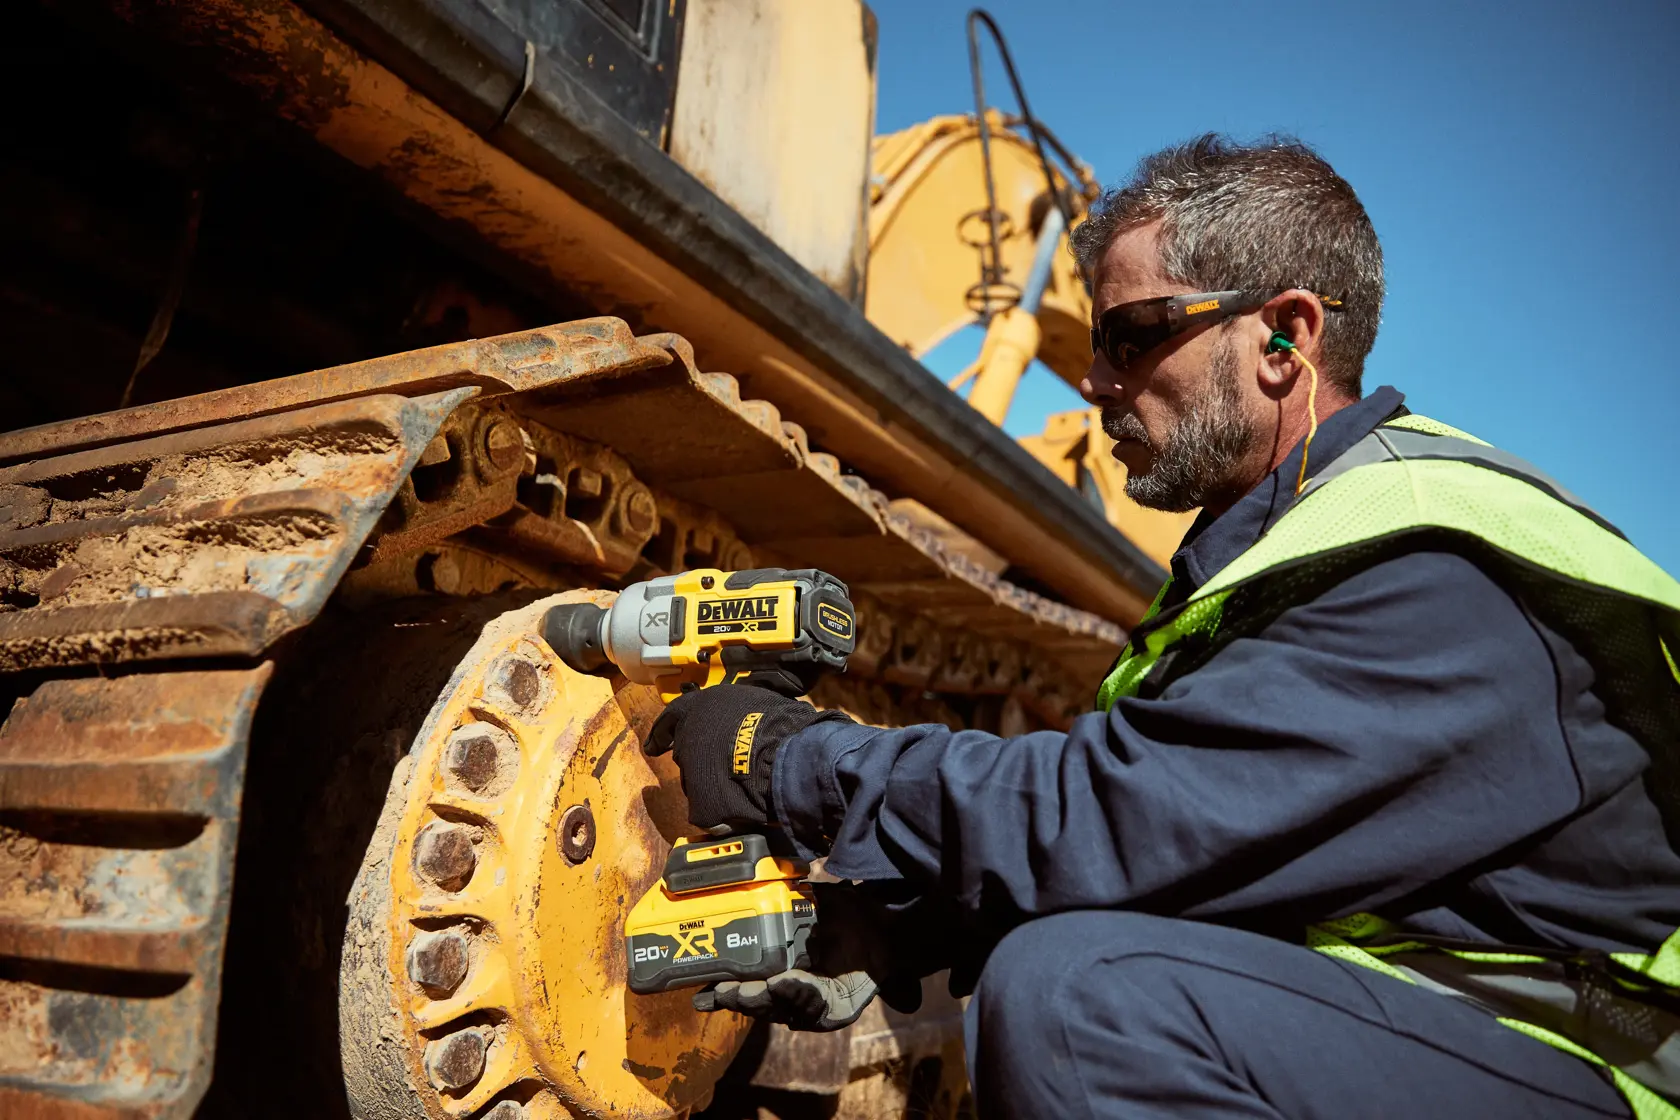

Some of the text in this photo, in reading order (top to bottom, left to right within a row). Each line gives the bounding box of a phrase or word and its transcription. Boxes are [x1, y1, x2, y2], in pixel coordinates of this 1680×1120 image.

[644, 611, 669, 628] XR
[741, 621, 759, 633] XR
[671, 927, 718, 959] XR
[672, 952, 714, 964] POWERPACK
